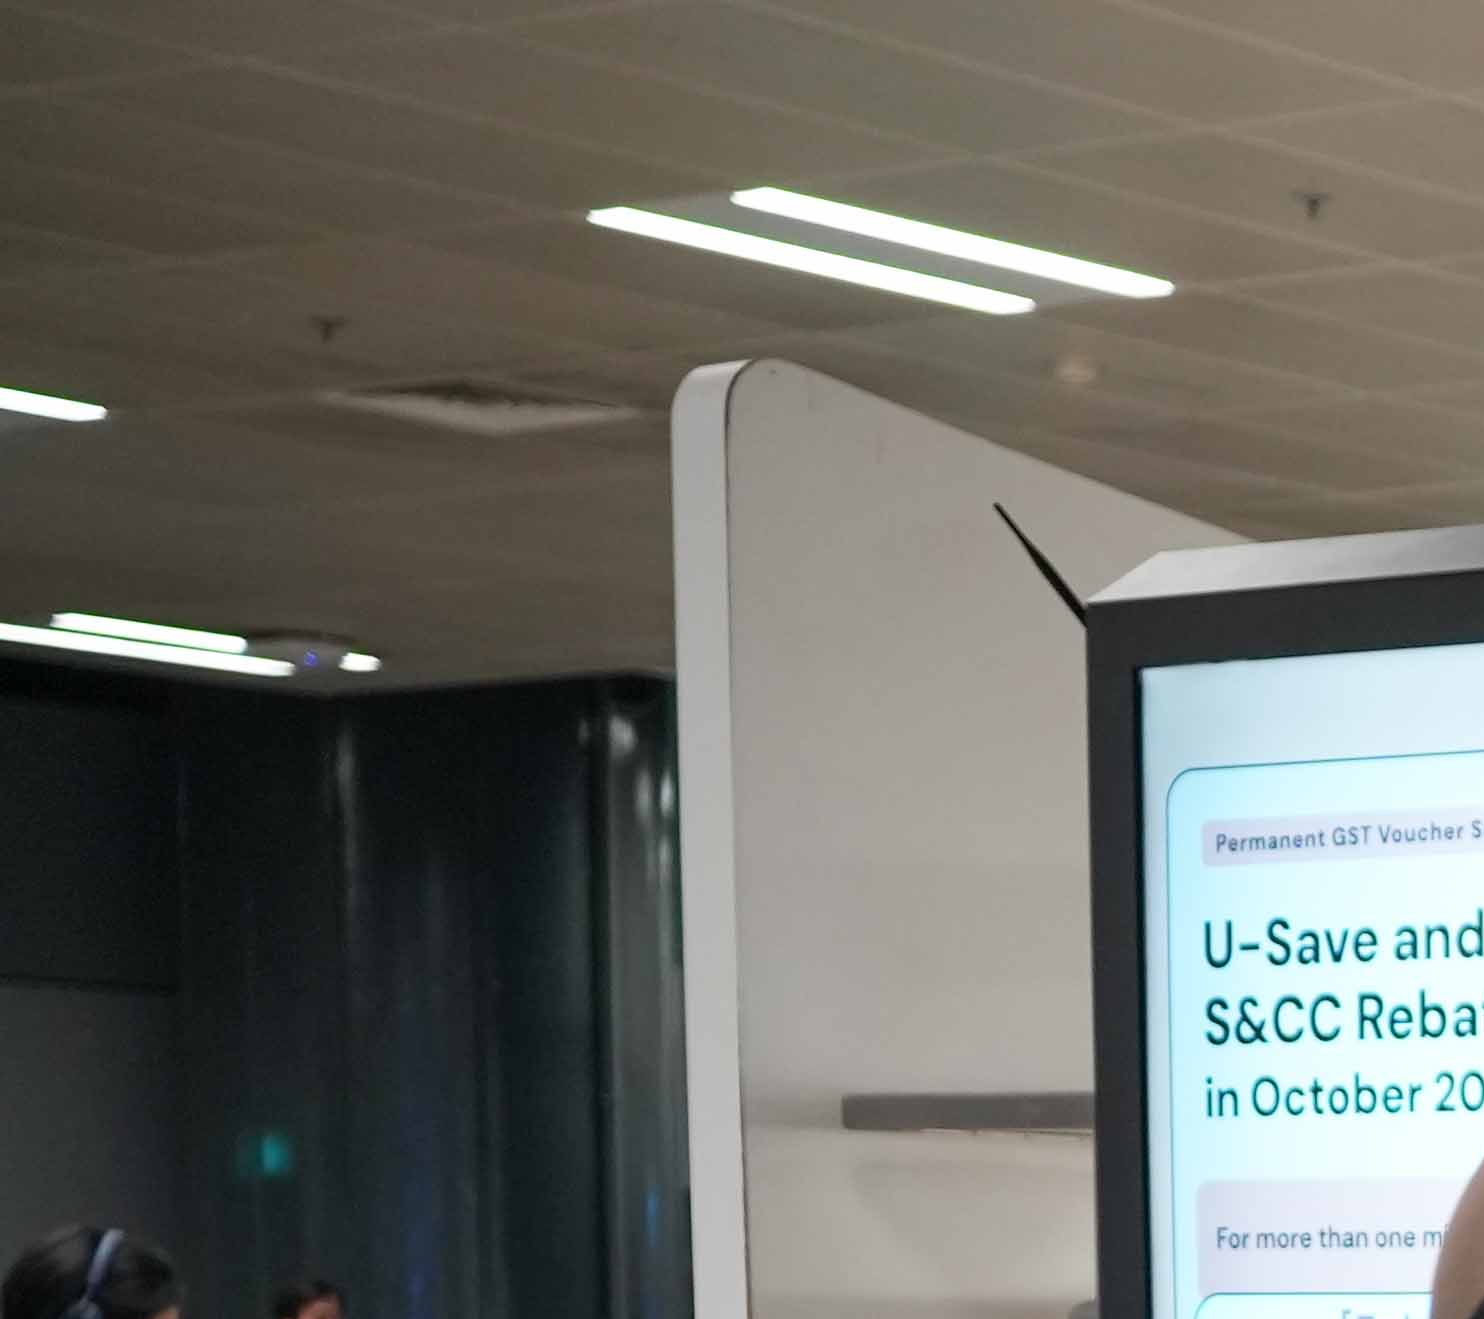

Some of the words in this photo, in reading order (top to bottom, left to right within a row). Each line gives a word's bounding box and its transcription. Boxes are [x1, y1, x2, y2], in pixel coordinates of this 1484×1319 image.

[1215, 829, 1326, 854] Permanent
[1331, 824, 1372, 847] GST
[1378, 820, 1465, 844] Voucher
[1204, 916, 1379, 969] U-Save
[1394, 906, 1484, 961] and
[1205, 992, 1342, 1046] S&CC
[1205, 1075, 1239, 1118] in
[1251, 1071, 1423, 1117] October
[1216, 1226, 1250, 1249] For
[1256, 1230, 1312, 1249] more
[1318, 1225, 1369, 1248] than
[1375, 1230, 1416, 1248] one
